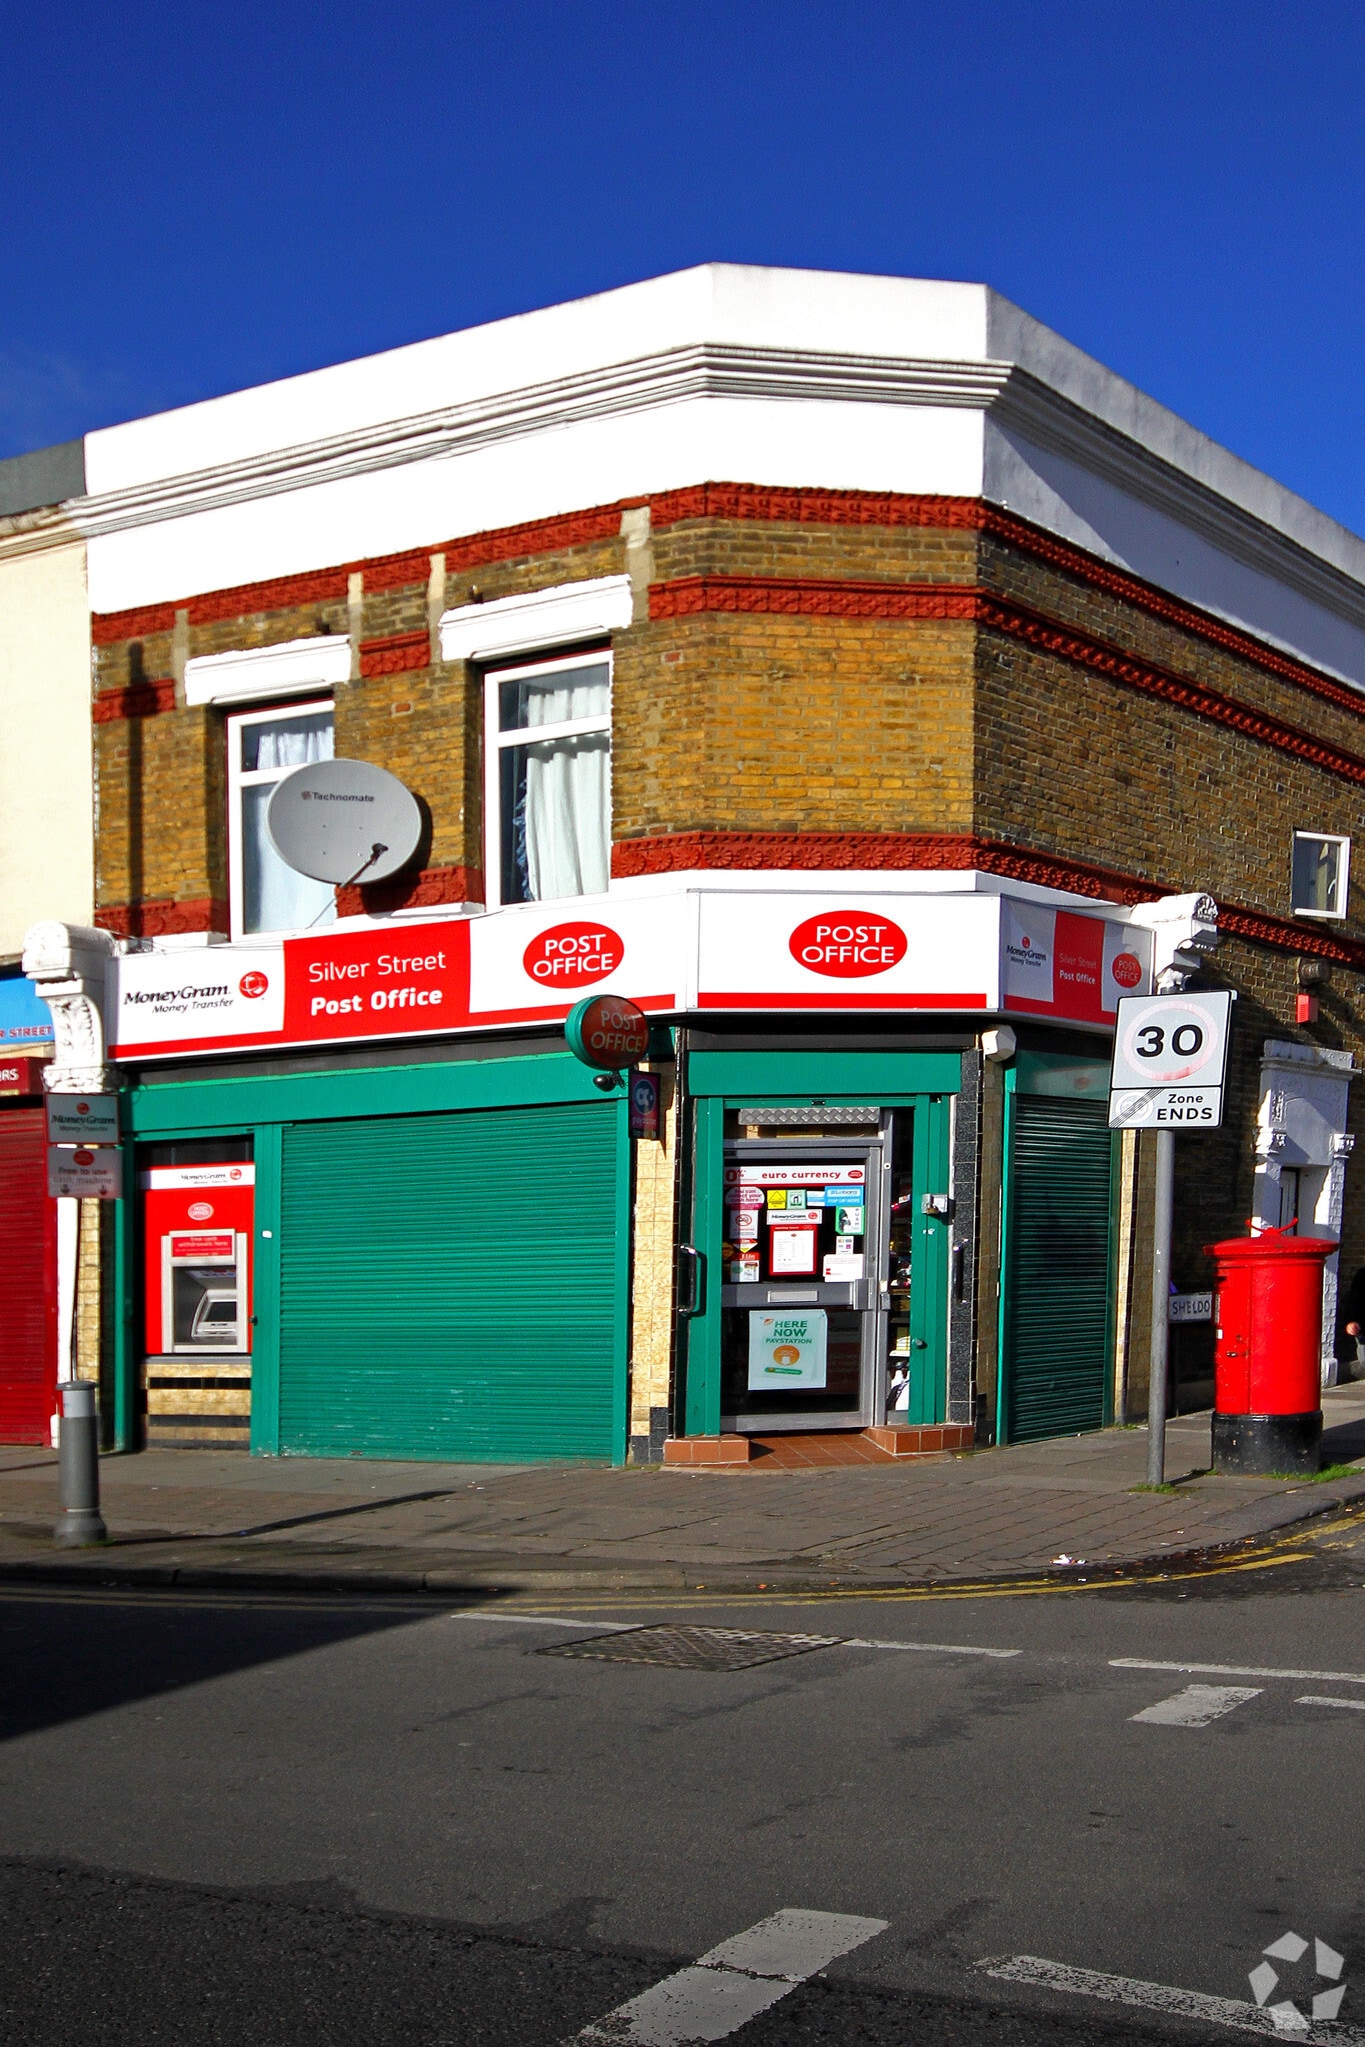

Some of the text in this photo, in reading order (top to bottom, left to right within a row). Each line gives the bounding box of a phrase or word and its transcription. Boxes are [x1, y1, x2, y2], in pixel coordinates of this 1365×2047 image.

[312, 791, 375, 802] Technomate
[816, 925, 887, 943] POST
[545, 933, 607, 957] POST
[1006, 945, 1047, 961] MoneyGram
[802, 945, 895, 963] OFFICE
[308, 951, 447, 983] Silver Street
[532, 952, 614, 977] OFFICE
[1118, 960, 1136, 971] POST
[1059, 969, 1096, 985] Post Office
[1114, 970, 1139, 982] OFFICE
[124, 985, 229, 1005] MoneyGram
[311, 987, 443, 1017] Post Office
[152, 998, 234, 1014] Money Transfer
[600, 1010, 643, 1032] POST
[9, 1026, 52, 1038] STREET
[590, 1031, 643, 1053] OFFICE
[1136, 1024, 1204, 1058] 30
[0, 1068, 19, 1081] RS
[1168, 1093, 1204, 1104] Zone
[1157, 1107, 1213, 1120] ENDS
[761, 1171, 788, 1179] euro
[791, 1170, 842, 1180] currency
[774, 1320, 809, 1328] HERE
[773, 1328, 807, 1337] NOW
